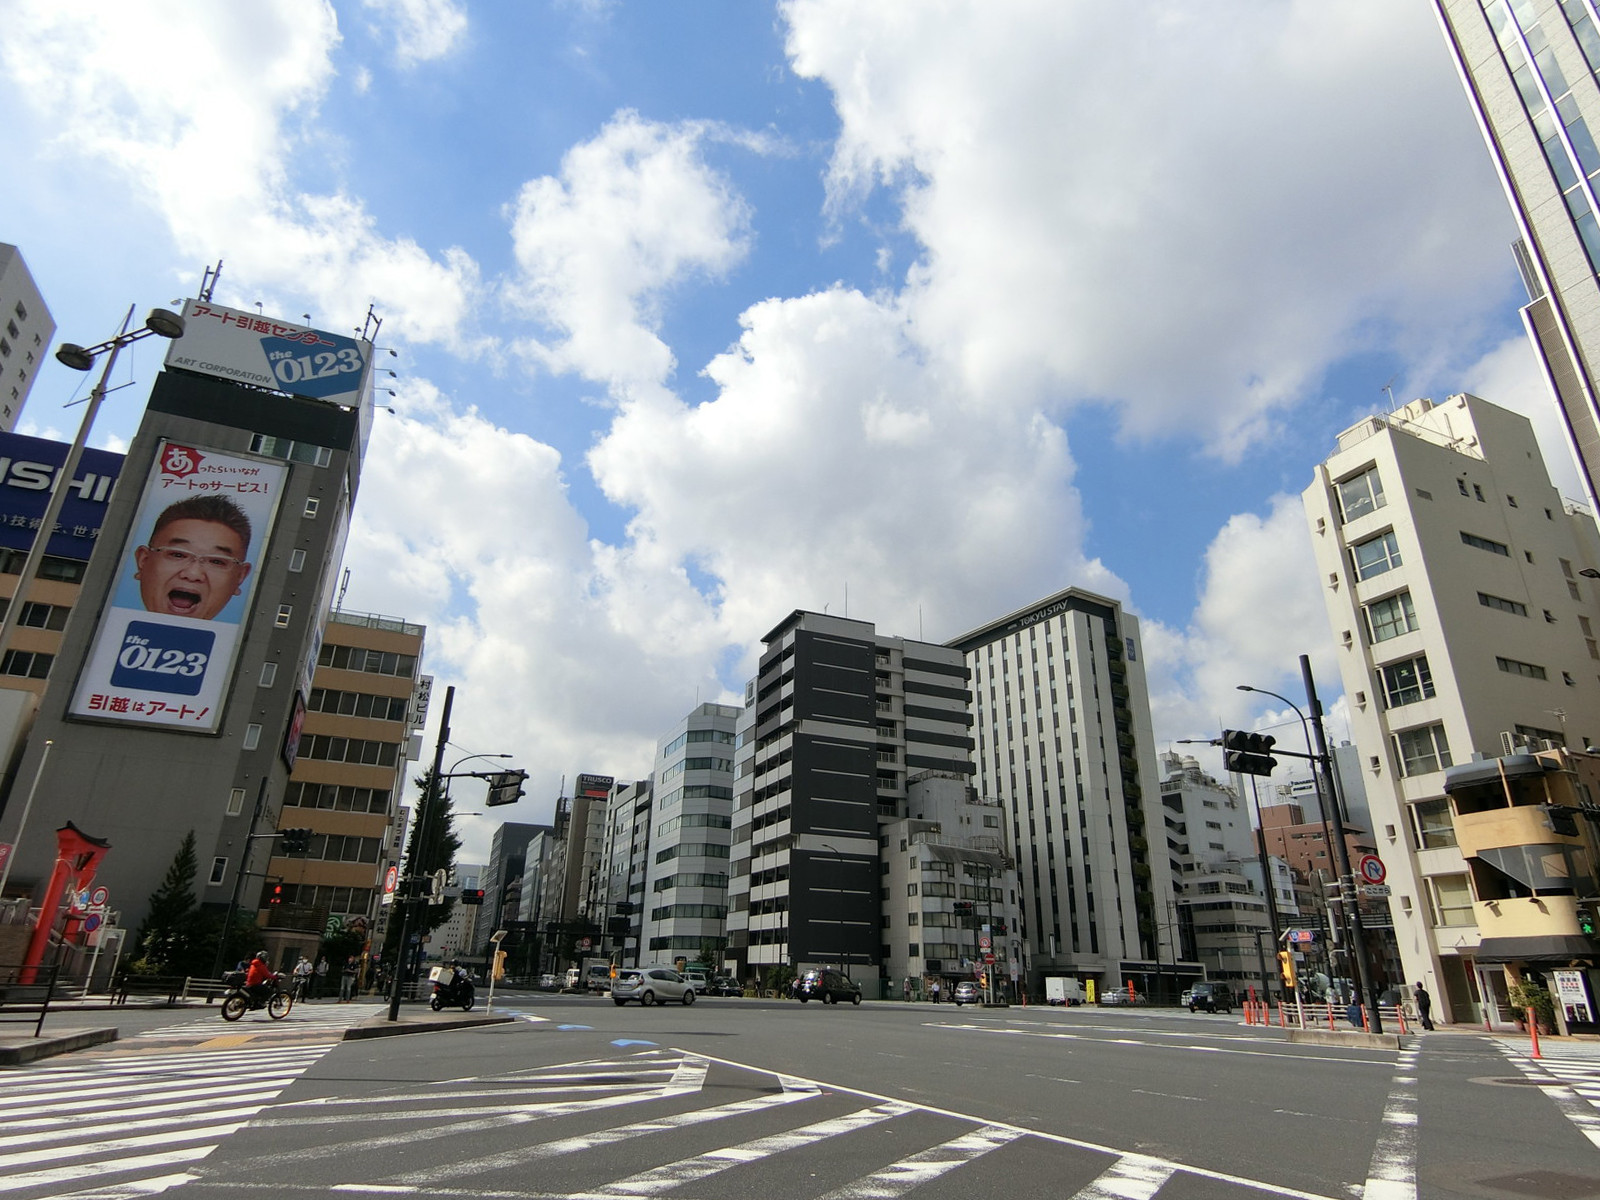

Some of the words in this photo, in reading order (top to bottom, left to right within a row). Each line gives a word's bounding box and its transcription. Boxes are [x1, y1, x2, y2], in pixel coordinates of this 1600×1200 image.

[191, 305, 336, 347] アート引越センター
[269, 350, 293, 361] the
[274, 348, 362, 384] 0123
[174, 356, 197, 367] ART
[199, 361, 272, 384] CORPORATION
[161, 478, 269, 494] アートのサービス!
[1019, 609, 1047, 627] TOKYU
[1047, 599, 1068, 616] STAY
[125, 635, 150, 646] the
[119, 645, 208, 677] 0123
[88, 694, 210, 721] 引越はアート!
[413, 680, 432, 725] 村松ビル
[582, 775, 612, 784] TRUSCO
